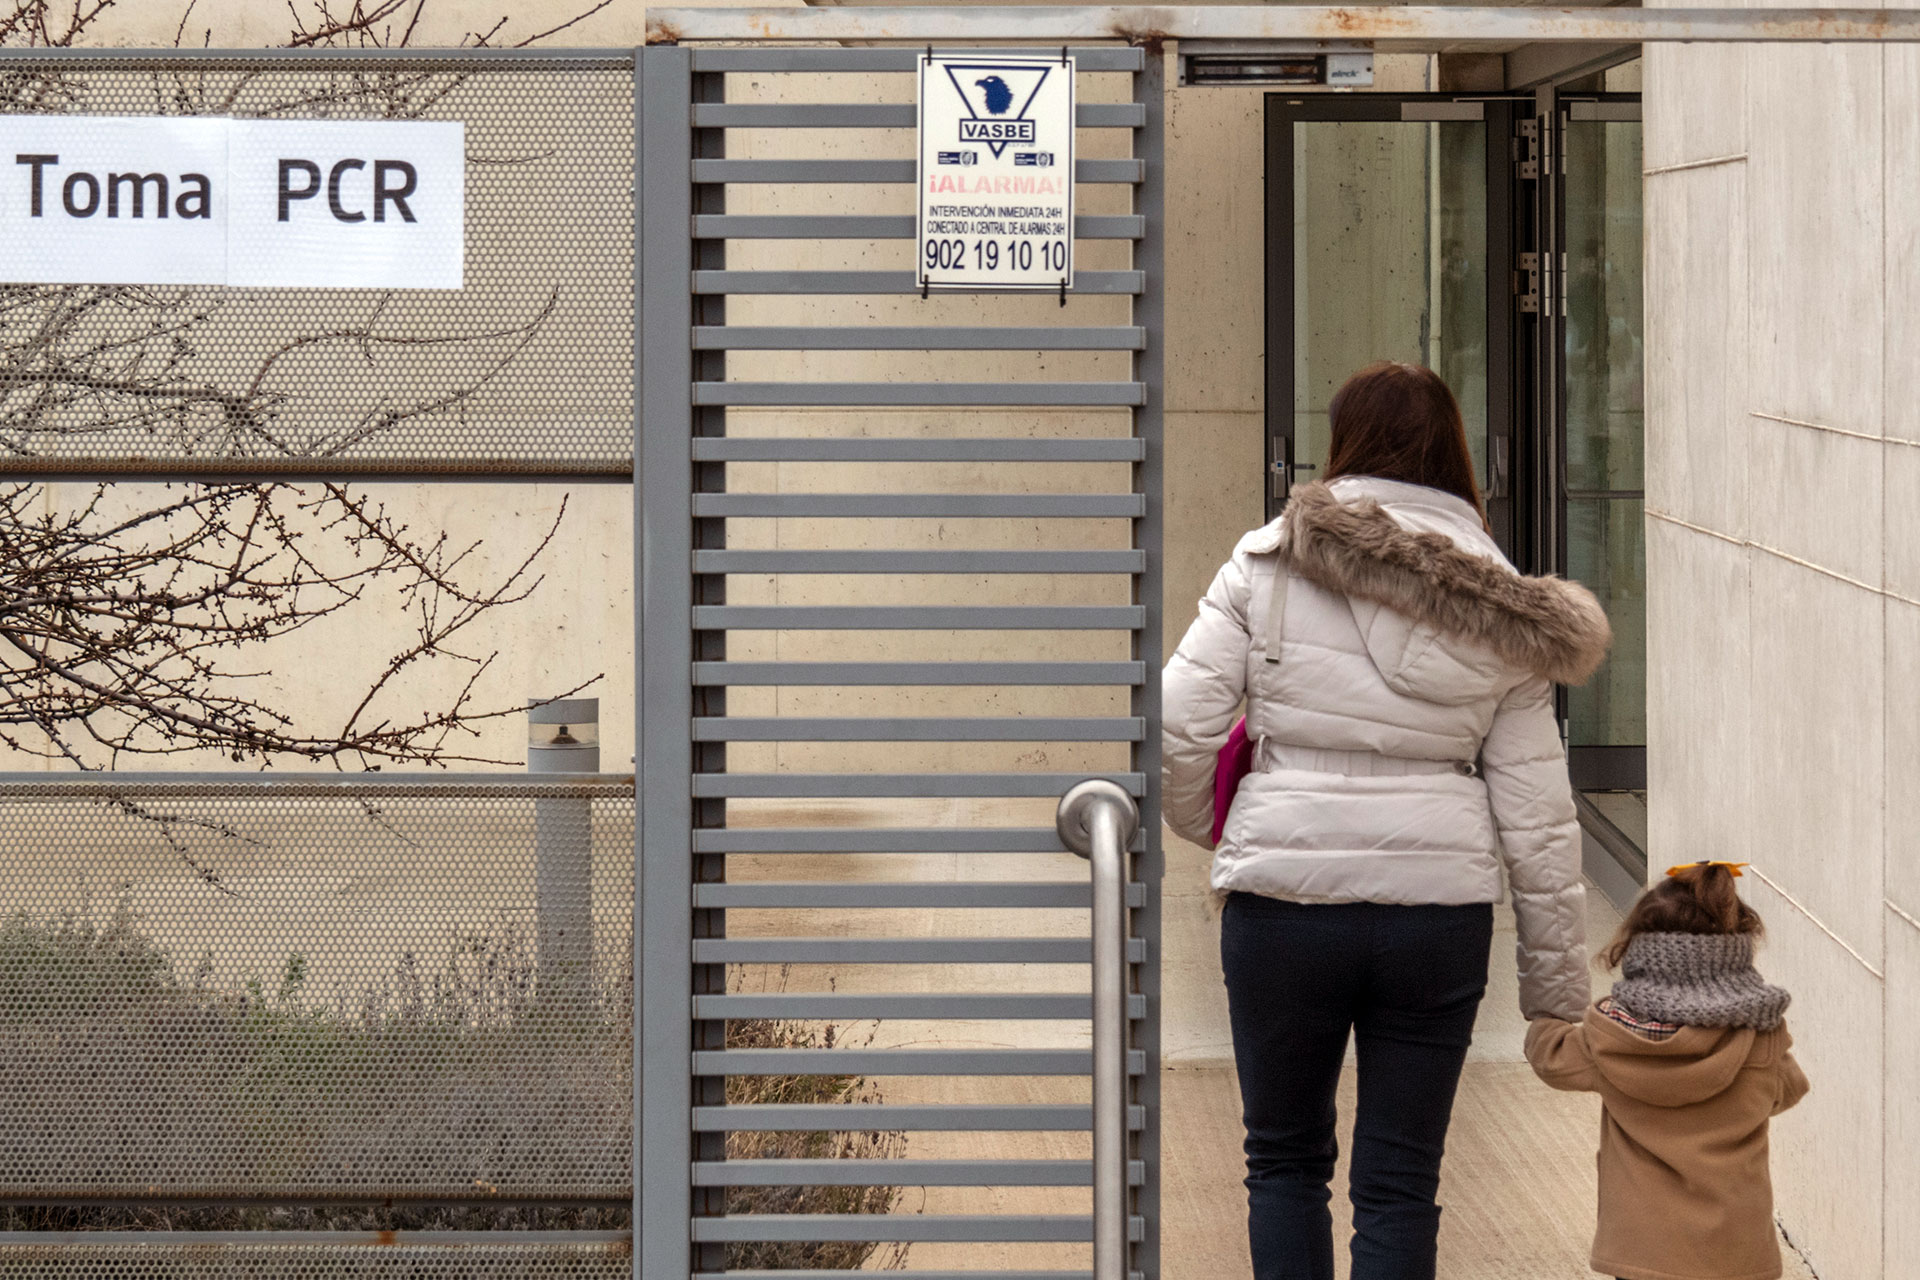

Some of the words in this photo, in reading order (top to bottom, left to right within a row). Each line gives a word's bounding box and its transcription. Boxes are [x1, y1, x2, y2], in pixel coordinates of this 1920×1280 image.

[964, 124, 1030, 138] VASBE
[16, 154, 211, 219] Toma
[277, 158, 418, 223] PCR
[929, 204, 996, 218] INTERVENCIÓN
[998, 206, 1044, 218] INMEDIATA
[1046, 207, 1062, 218] 24H
[927, 221, 968, 234] CONECTADO
[970, 222, 975, 234] A
[976, 221, 1007, 234] CENTRAL
[1009, 222, 1018, 234] DE
[1019, 222, 1051, 235] ALARMAS
[1053, 223, 1065, 235] 24H
[926, 239, 965, 270] 902
[974, 240, 999, 270] 19
[1007, 240, 1032, 271] 10
[1041, 240, 1066, 271] 10
